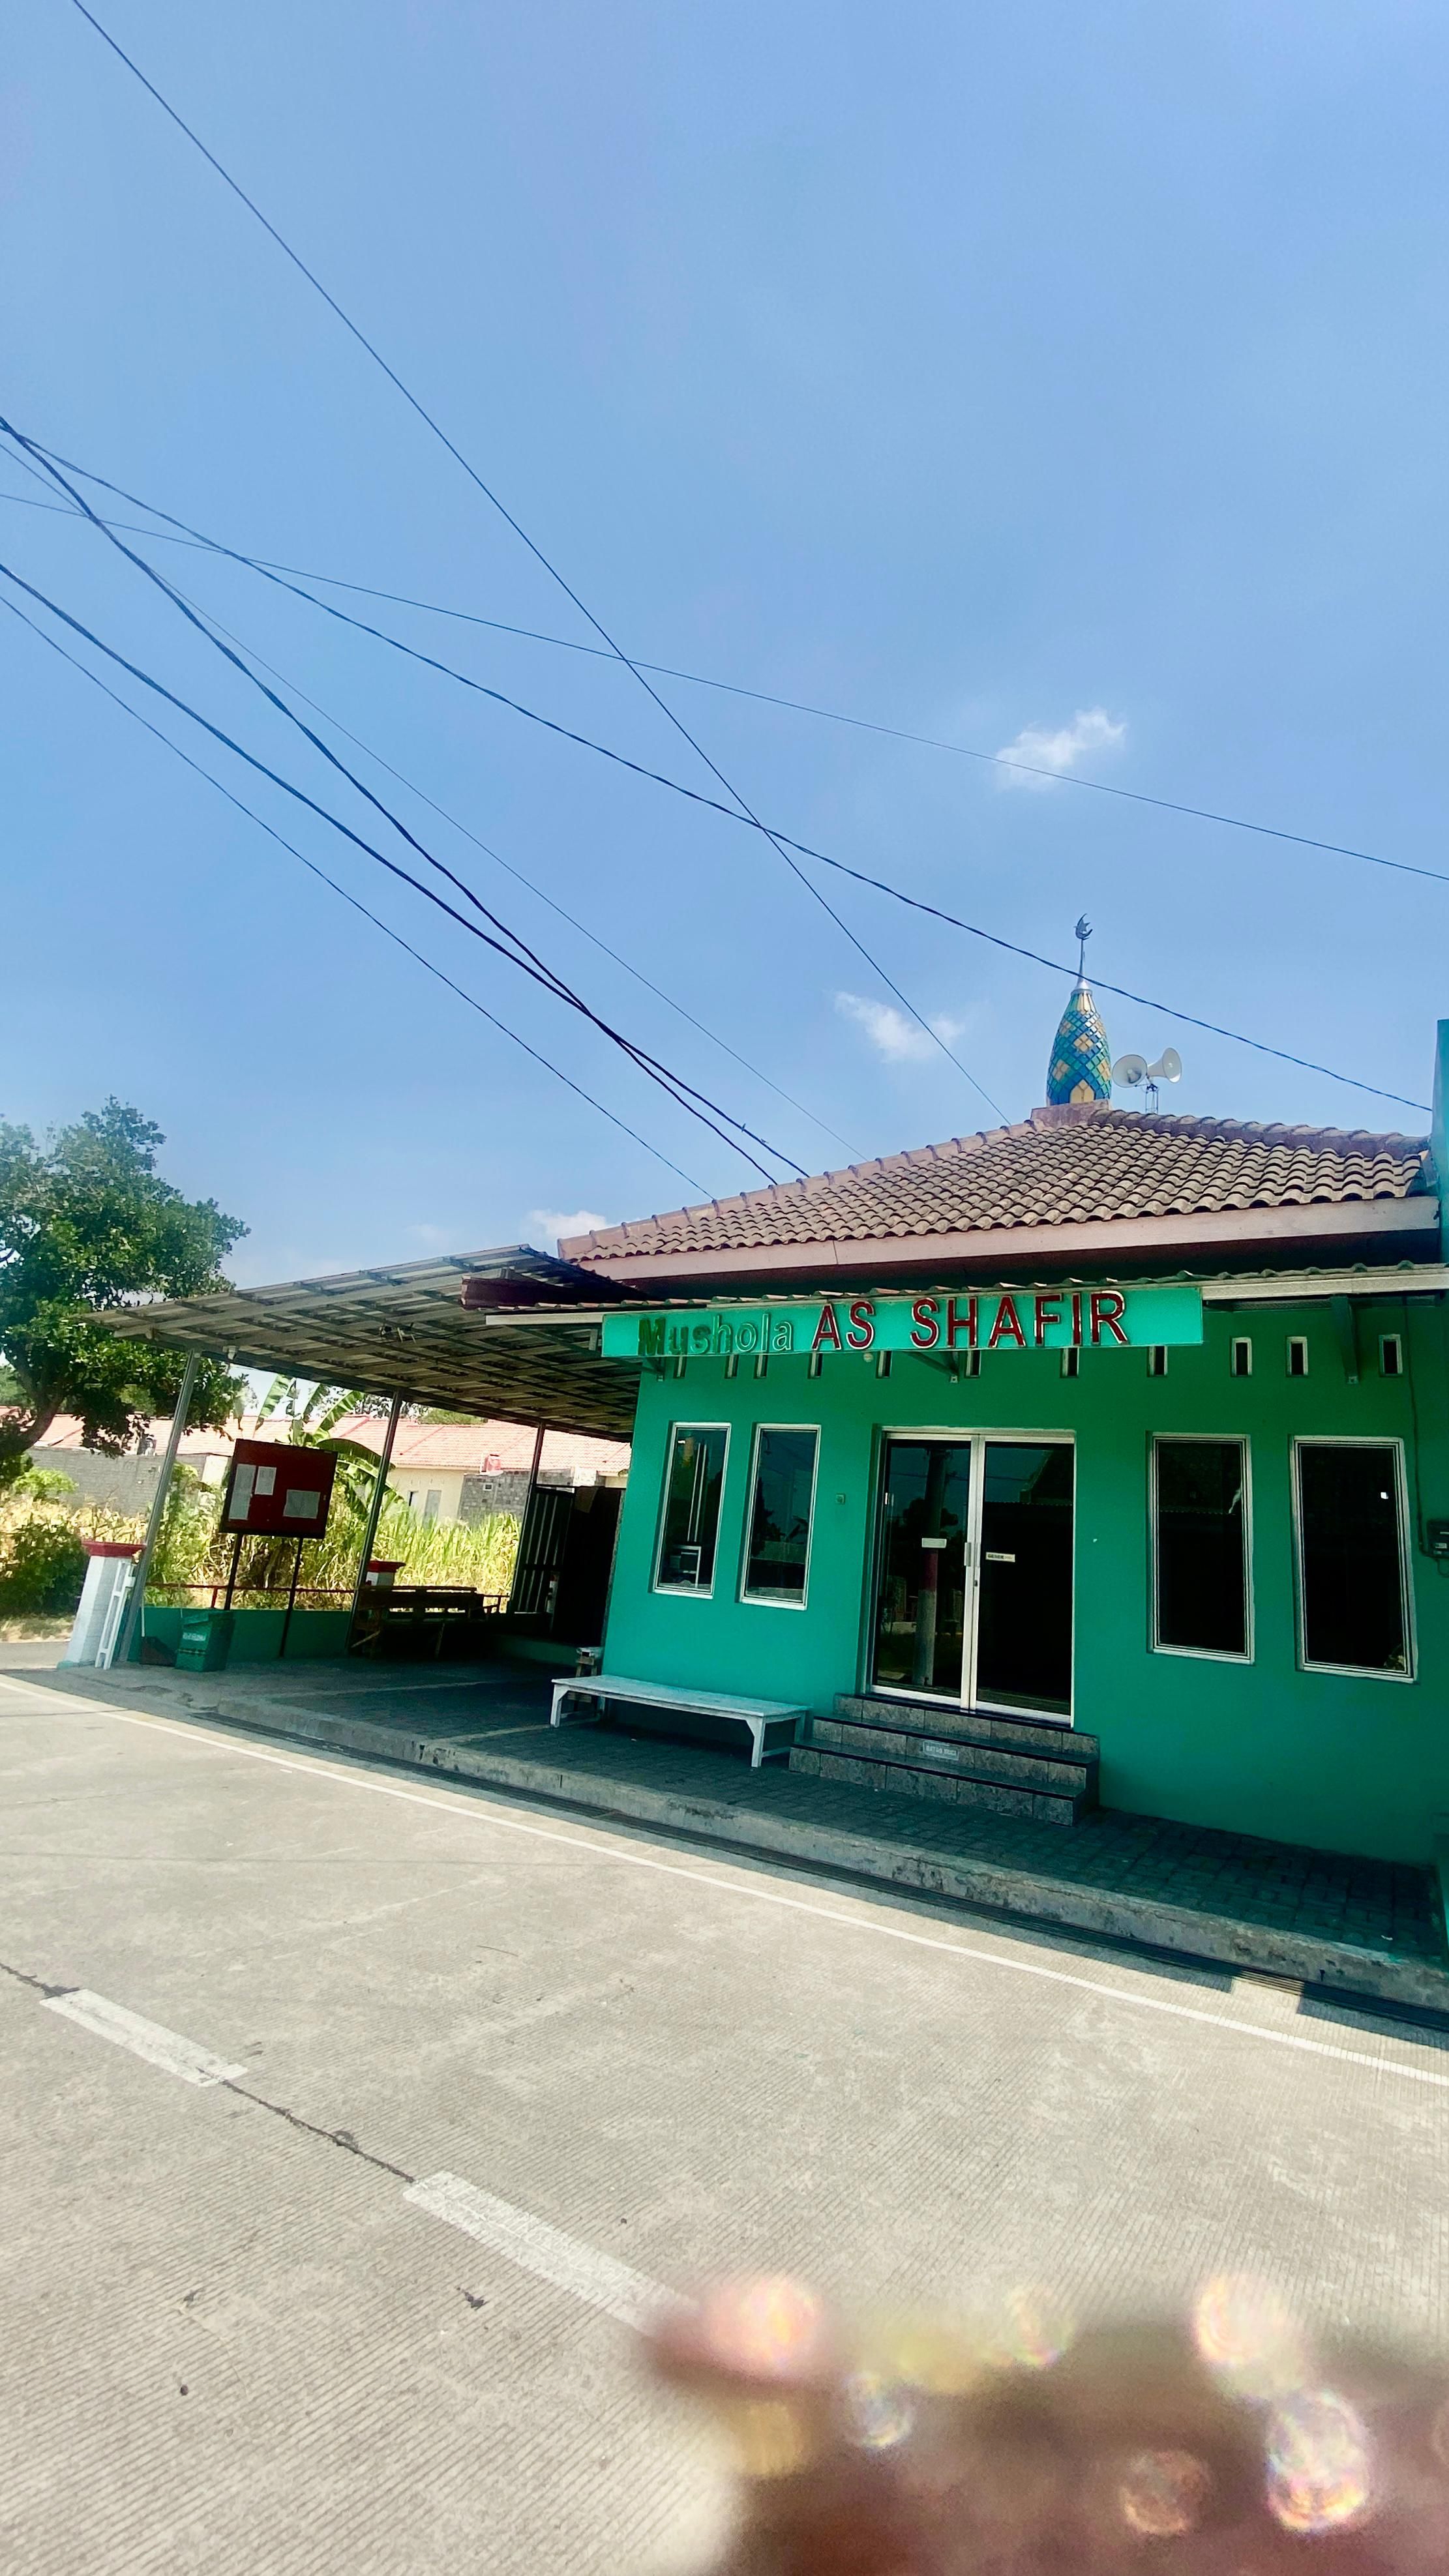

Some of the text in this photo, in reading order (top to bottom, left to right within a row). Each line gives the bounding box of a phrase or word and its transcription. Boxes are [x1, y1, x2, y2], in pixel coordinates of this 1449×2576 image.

[637, 1290, 1128, 1355] Mushola AS SHAFIR
